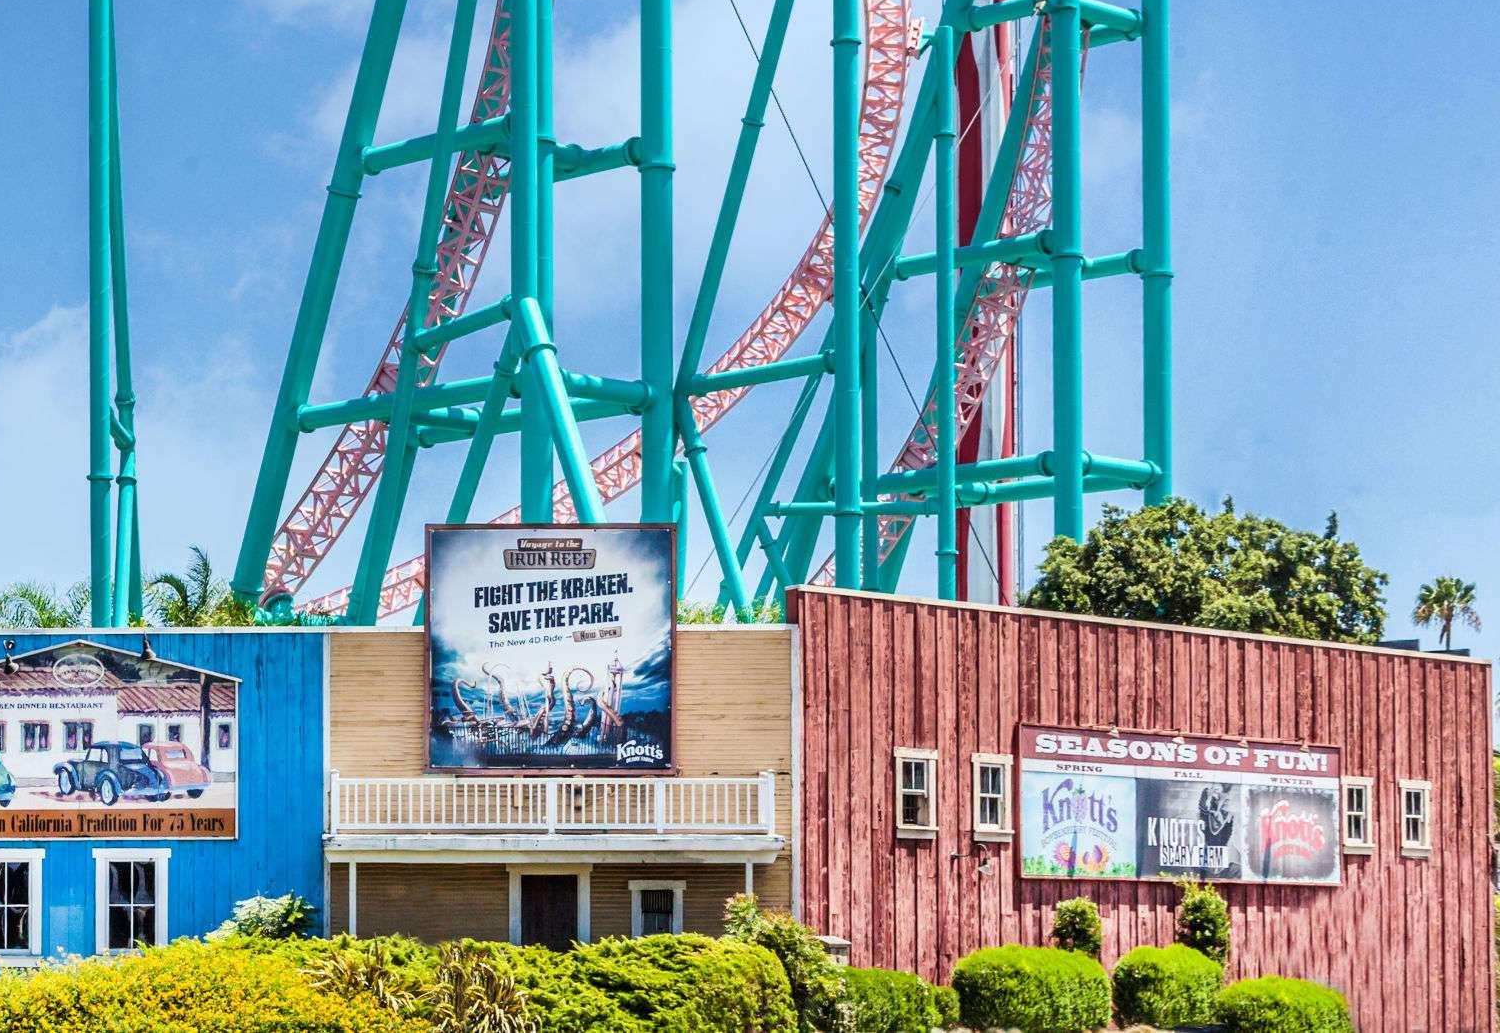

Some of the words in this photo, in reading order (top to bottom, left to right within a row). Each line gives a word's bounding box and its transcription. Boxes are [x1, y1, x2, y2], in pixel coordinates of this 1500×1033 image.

[520, 539, 553, 549] Voyage
[555, 540, 565, 548] to
[566, 539, 580, 548] the
[509, 551, 547, 566] IRON
[550, 551, 592, 566] REEF
[474, 583, 524, 608] FIGHT
[526, 579, 558, 603] THE
[560, 572, 633, 600] KRAKEN.
[488, 609, 531, 633] SAVE
[534, 606, 566, 629] THE
[568, 601, 619, 626] PARK.
[529, 636, 541, 644] 4D
[543, 634, 563, 642] Ride
[1035, 733, 1198, 763] SEASONS
[1203, 745, 1249, 766] OF
[1253, 748, 1328, 772] FUN!
[1055, 763, 1103, 773] SPRING
[1174, 770, 1204, 778] FALL
[1269, 777, 1313, 785] WINTER
[11, 813, 73, 833] California
[77, 813, 137, 833] Tradition
[141, 813, 164, 832] For
[168, 813, 185, 832] 75
[189, 812, 226, 832] Years
[1161, 846, 1194, 866] SCARY
[1198, 846, 1227, 867] FARM
